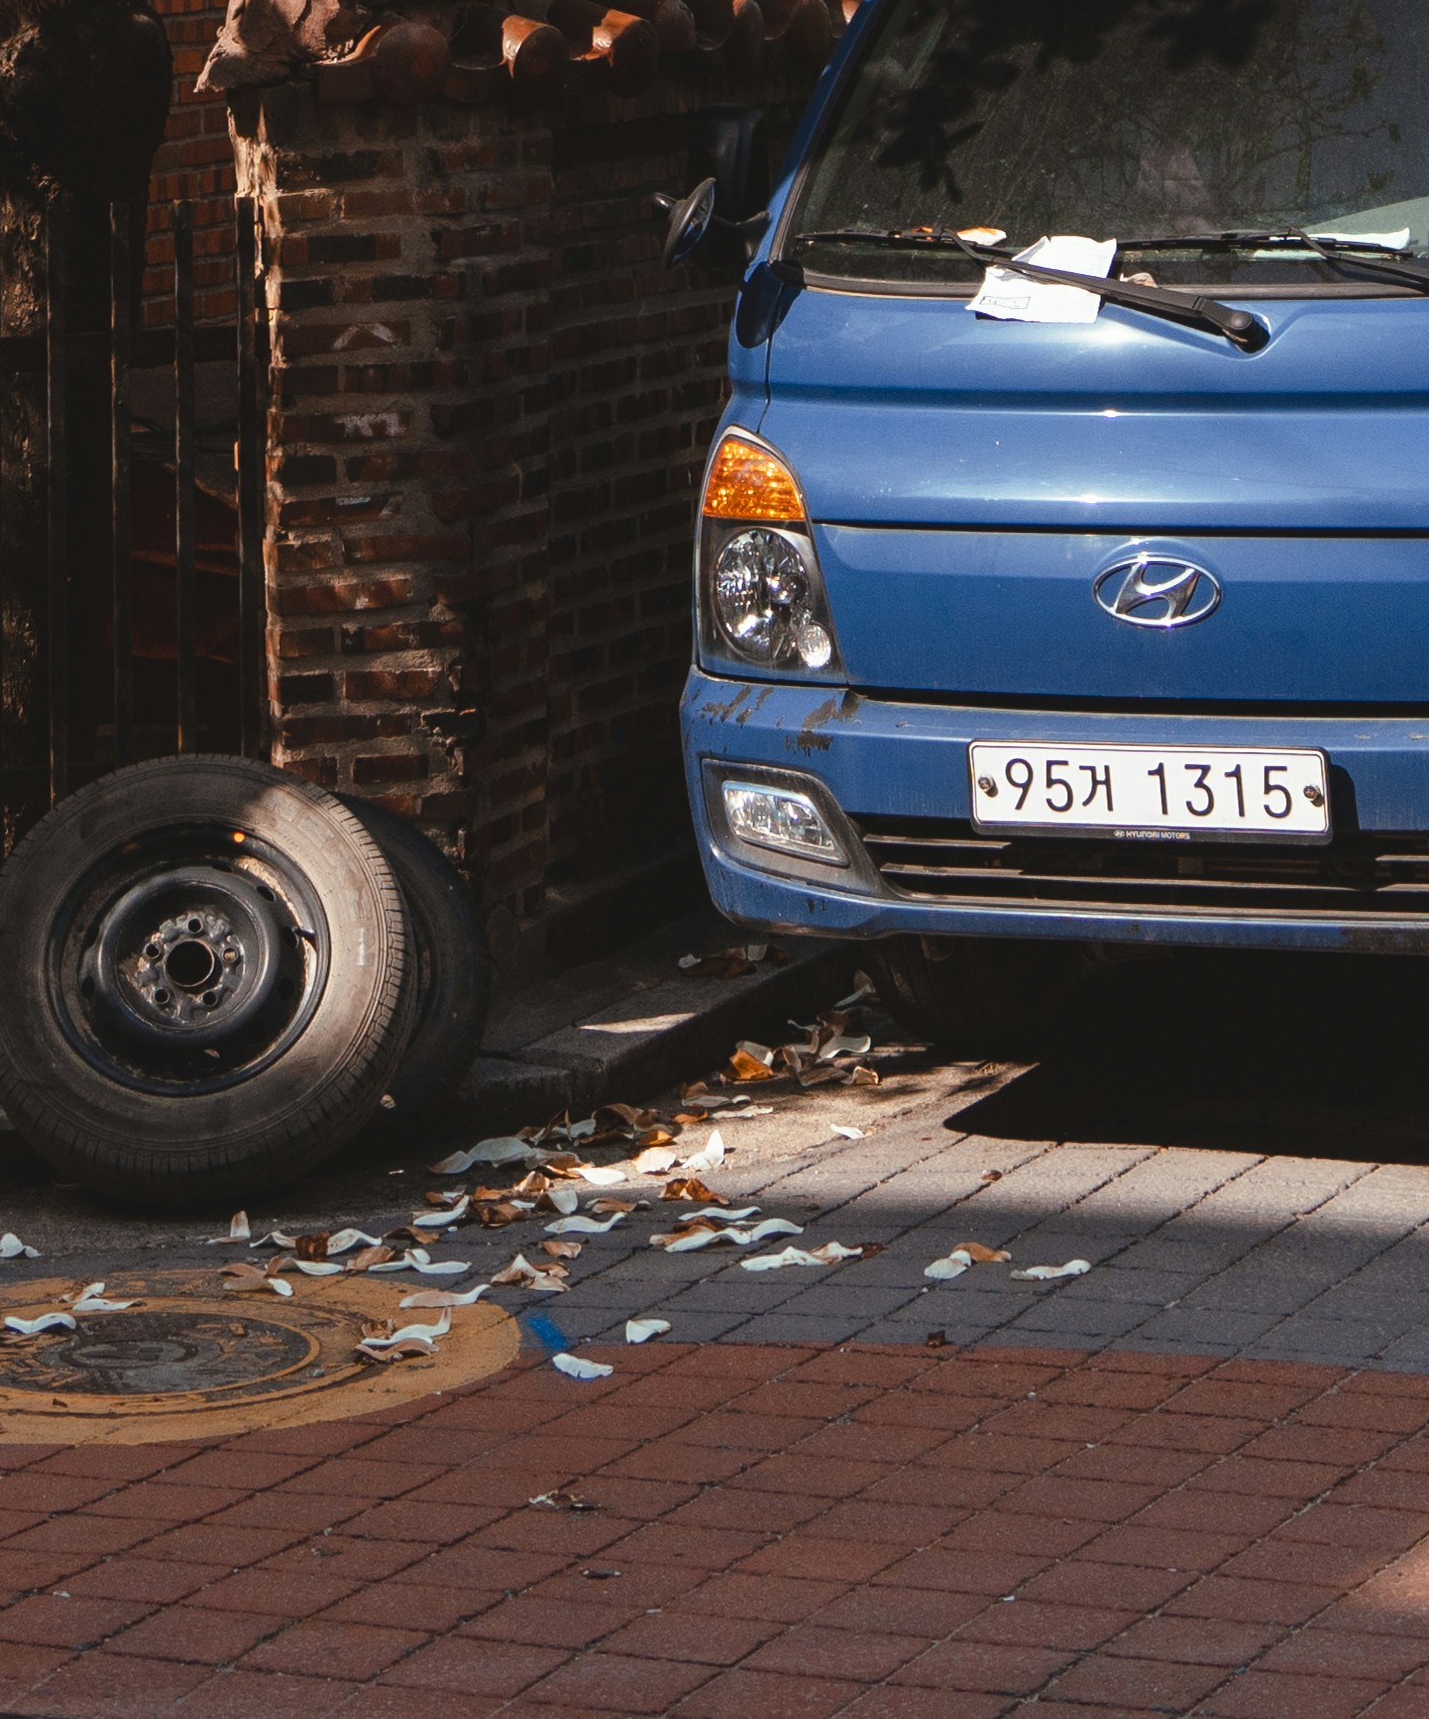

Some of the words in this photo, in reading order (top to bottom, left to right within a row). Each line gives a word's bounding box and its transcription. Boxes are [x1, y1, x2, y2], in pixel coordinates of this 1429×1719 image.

[1004, 757, 1115, 813] 95거
[1147, 761, 1294, 820] 1315
[1126, 830, 1160, 839] HYUNDAI
[1160, 831, 1191, 840] MOTORS
